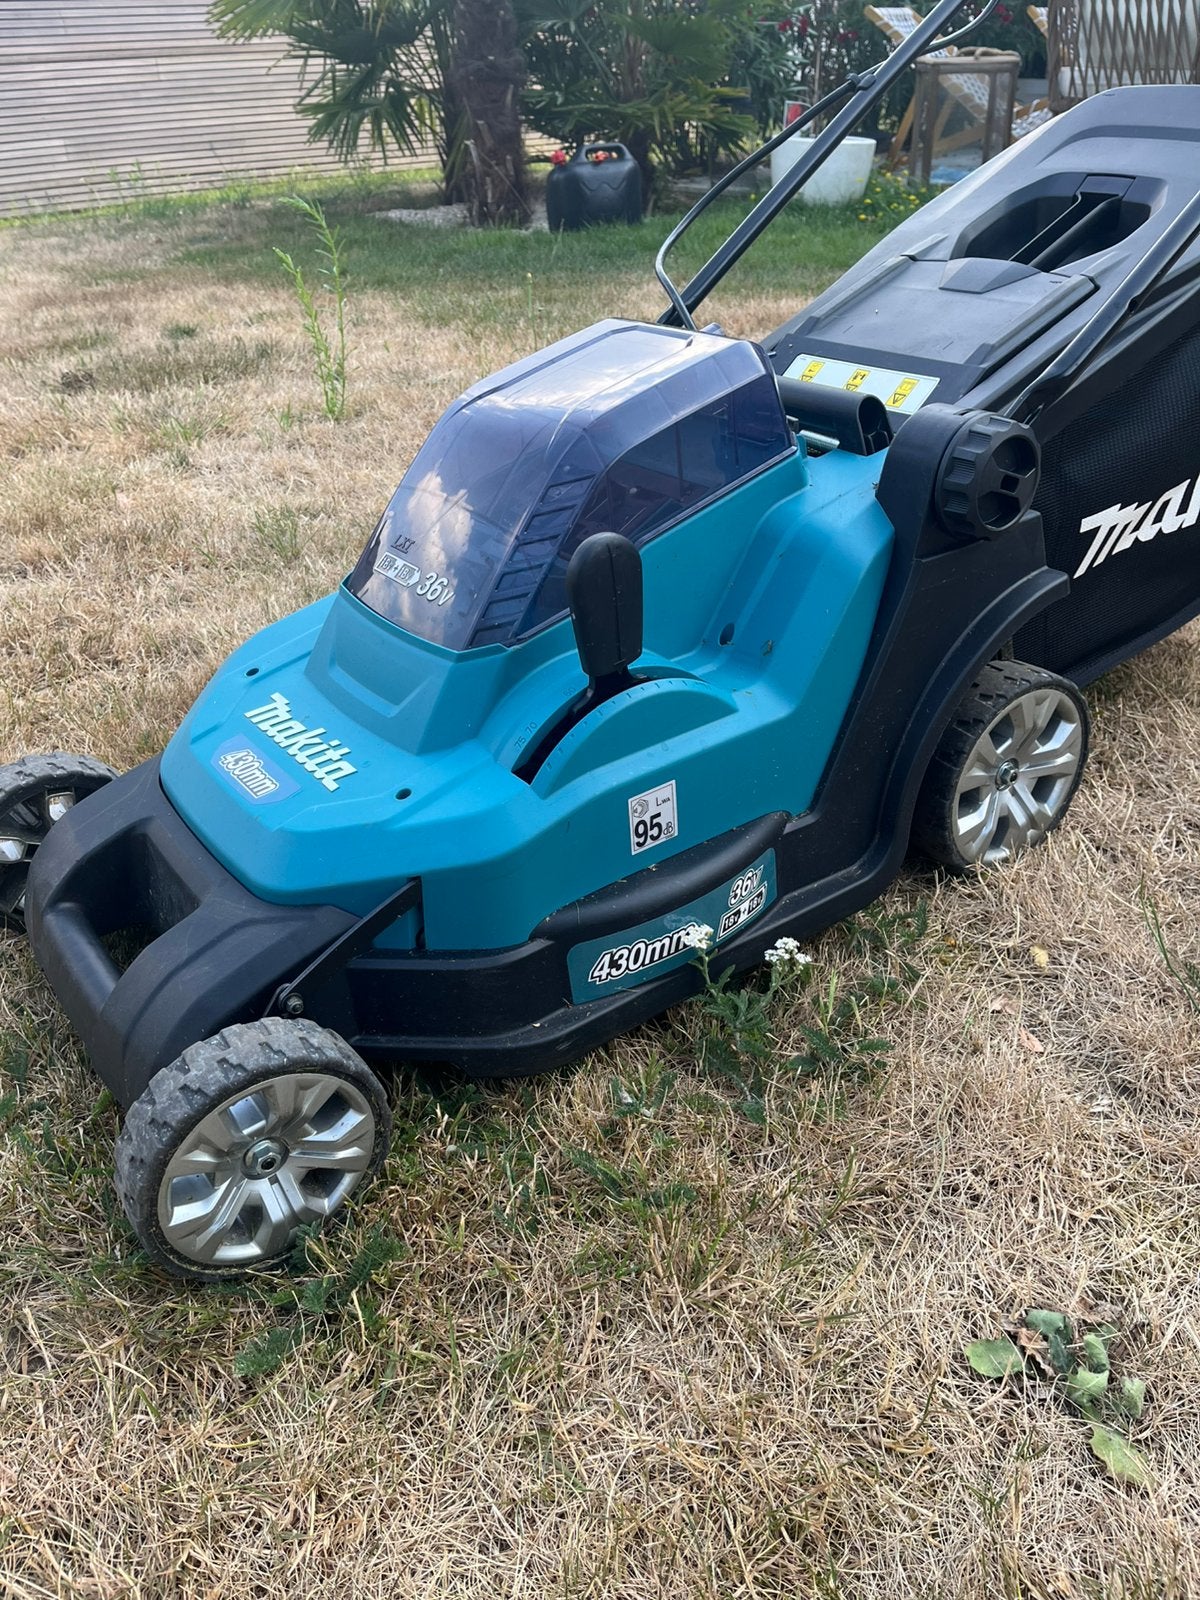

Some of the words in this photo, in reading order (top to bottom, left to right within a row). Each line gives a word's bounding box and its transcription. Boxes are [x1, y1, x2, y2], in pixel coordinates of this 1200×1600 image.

[525, 721, 538, 734] 70
[514, 735, 527, 749] 75
[219, 749, 279, 798] 430mm
[634, 812, 663, 848] 95
[663, 821, 674, 836] dB
